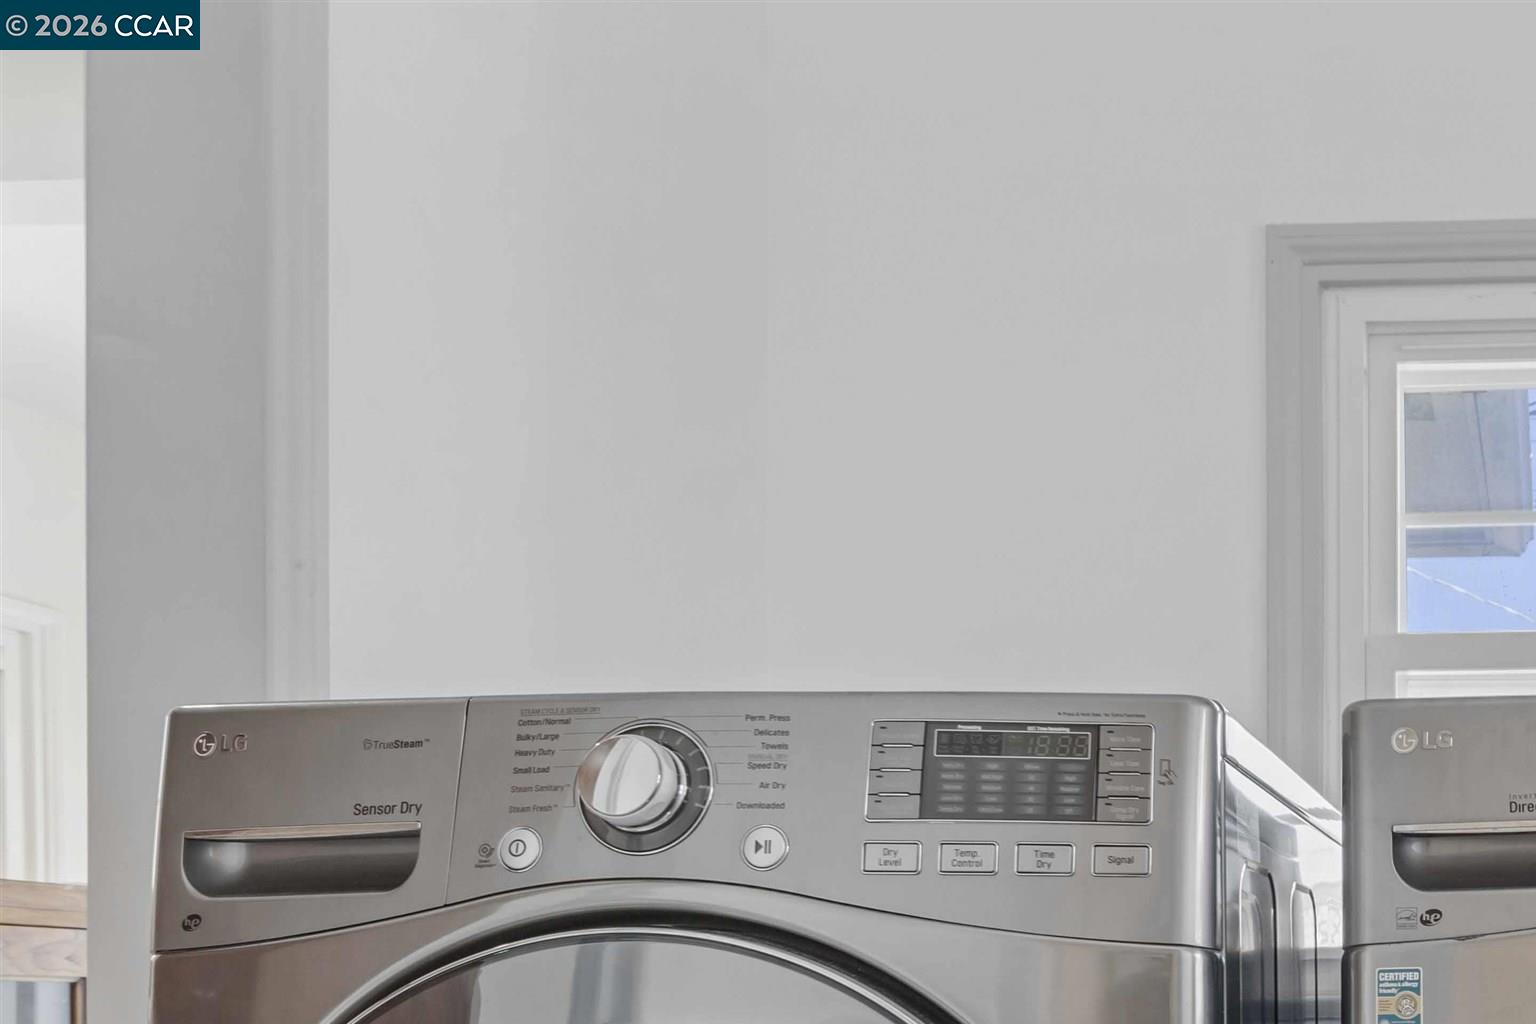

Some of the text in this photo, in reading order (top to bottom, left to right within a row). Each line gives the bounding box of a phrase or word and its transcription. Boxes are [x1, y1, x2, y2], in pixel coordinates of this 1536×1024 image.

[517, 717, 572, 727] Cotton/Normal
[769, 713, 791, 722] Press
[516, 733, 560, 742] Bulky/Large
[753, 728, 790, 737] Delicates
[220, 733, 248, 752] LG
[1422, 730, 1454, 750] LG
[761, 742, 789, 751] Towels
[514, 748, 556, 757] Heavy Duty
[512, 766, 551, 774] Small Load
[747, 762, 788, 771] Speed Dry
[510, 785, 533, 793] Steam
[759, 781, 787, 791] Air Dry
[353, 801, 423, 817] Sensor Dry
[736, 801, 786, 810] Downloaded
[883, 847, 898, 858] Dry
[1033, 849, 1056, 859] Time
[878, 858, 902, 867] Level
[951, 858, 983, 868] Control
[1036, 859, 1052, 870] Dry
[1107, 855, 1135, 866] Signal
[1378, 971, 1419, 982] CERTIFIED
